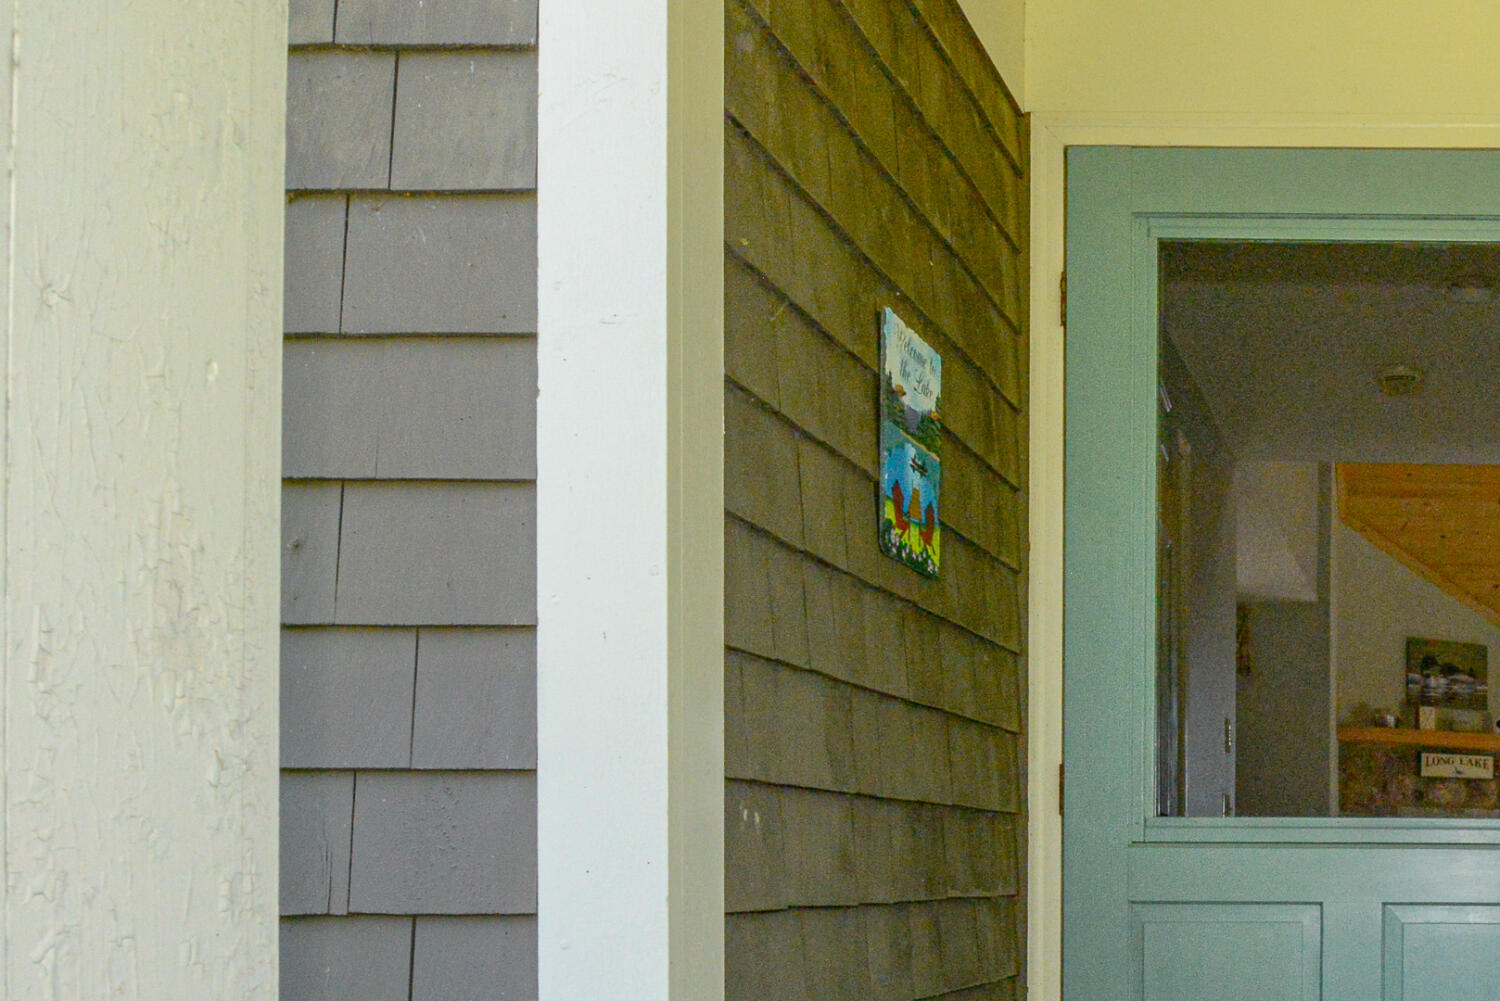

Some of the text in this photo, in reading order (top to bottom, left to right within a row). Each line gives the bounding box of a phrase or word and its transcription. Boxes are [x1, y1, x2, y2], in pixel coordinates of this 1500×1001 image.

[895, 322, 927, 369] Welcome
[900, 358, 935, 398] the Lake
[1425, 755, 1489, 769] LONG LAKE
